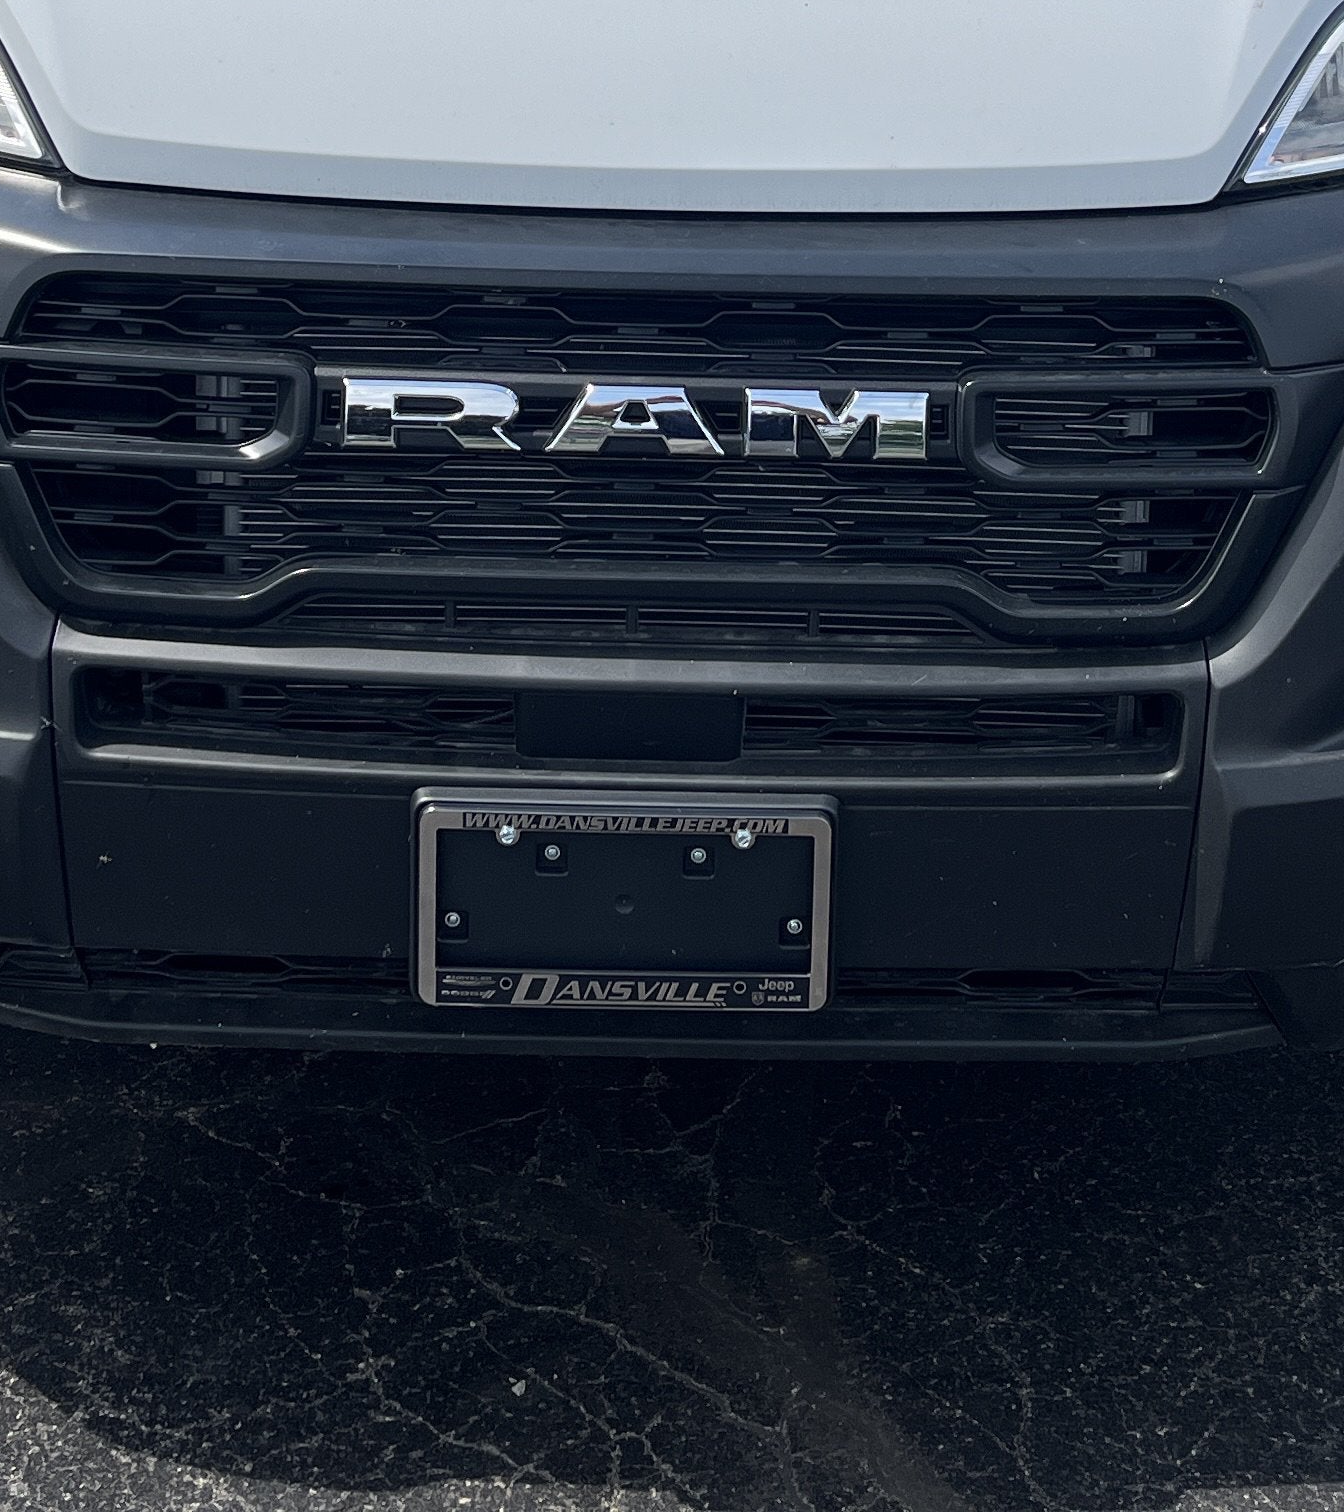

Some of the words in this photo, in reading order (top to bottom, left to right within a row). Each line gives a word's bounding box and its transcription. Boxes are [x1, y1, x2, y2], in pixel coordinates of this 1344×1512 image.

[342, 376, 930, 461] RAM
[463, 812, 787, 834] WWW.DANSVILLEJEEP.COM
[510, 973, 734, 1006] DANSVILLE
[758, 977, 795, 994] Jeep
[767, 994, 802, 1004] RAM
